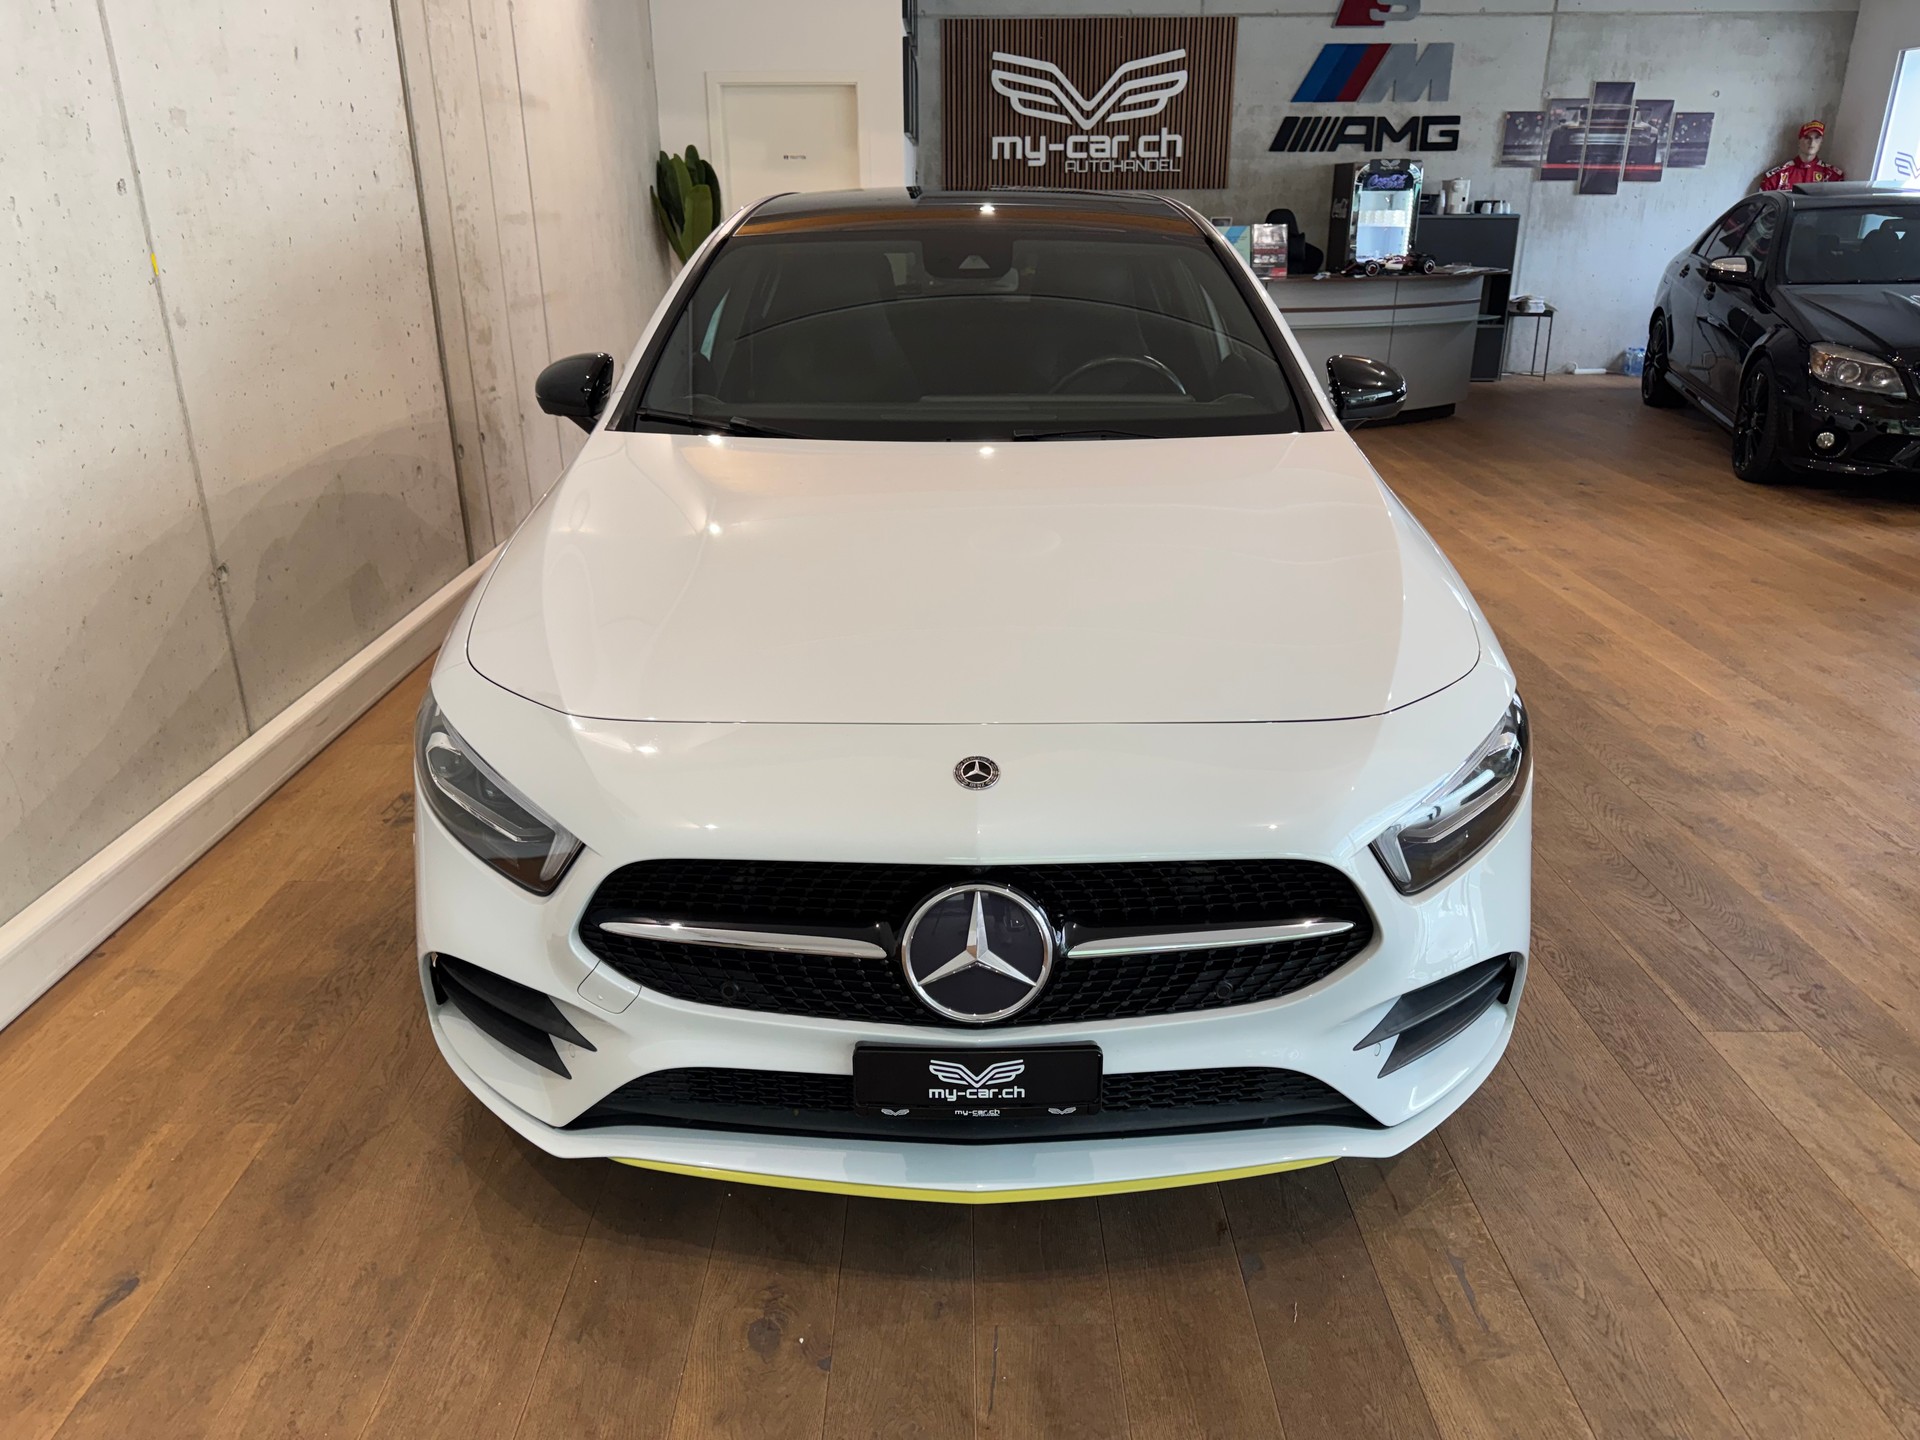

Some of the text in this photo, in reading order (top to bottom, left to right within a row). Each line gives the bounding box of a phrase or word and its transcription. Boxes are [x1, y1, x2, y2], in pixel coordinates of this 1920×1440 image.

[1327, 115, 1461, 152] AMG
[991, 127, 1183, 167] my-car.ch
[1064, 159, 1181, 174] AUTOHANDEL
[929, 1086, 1025, 1101] my-car.ch
